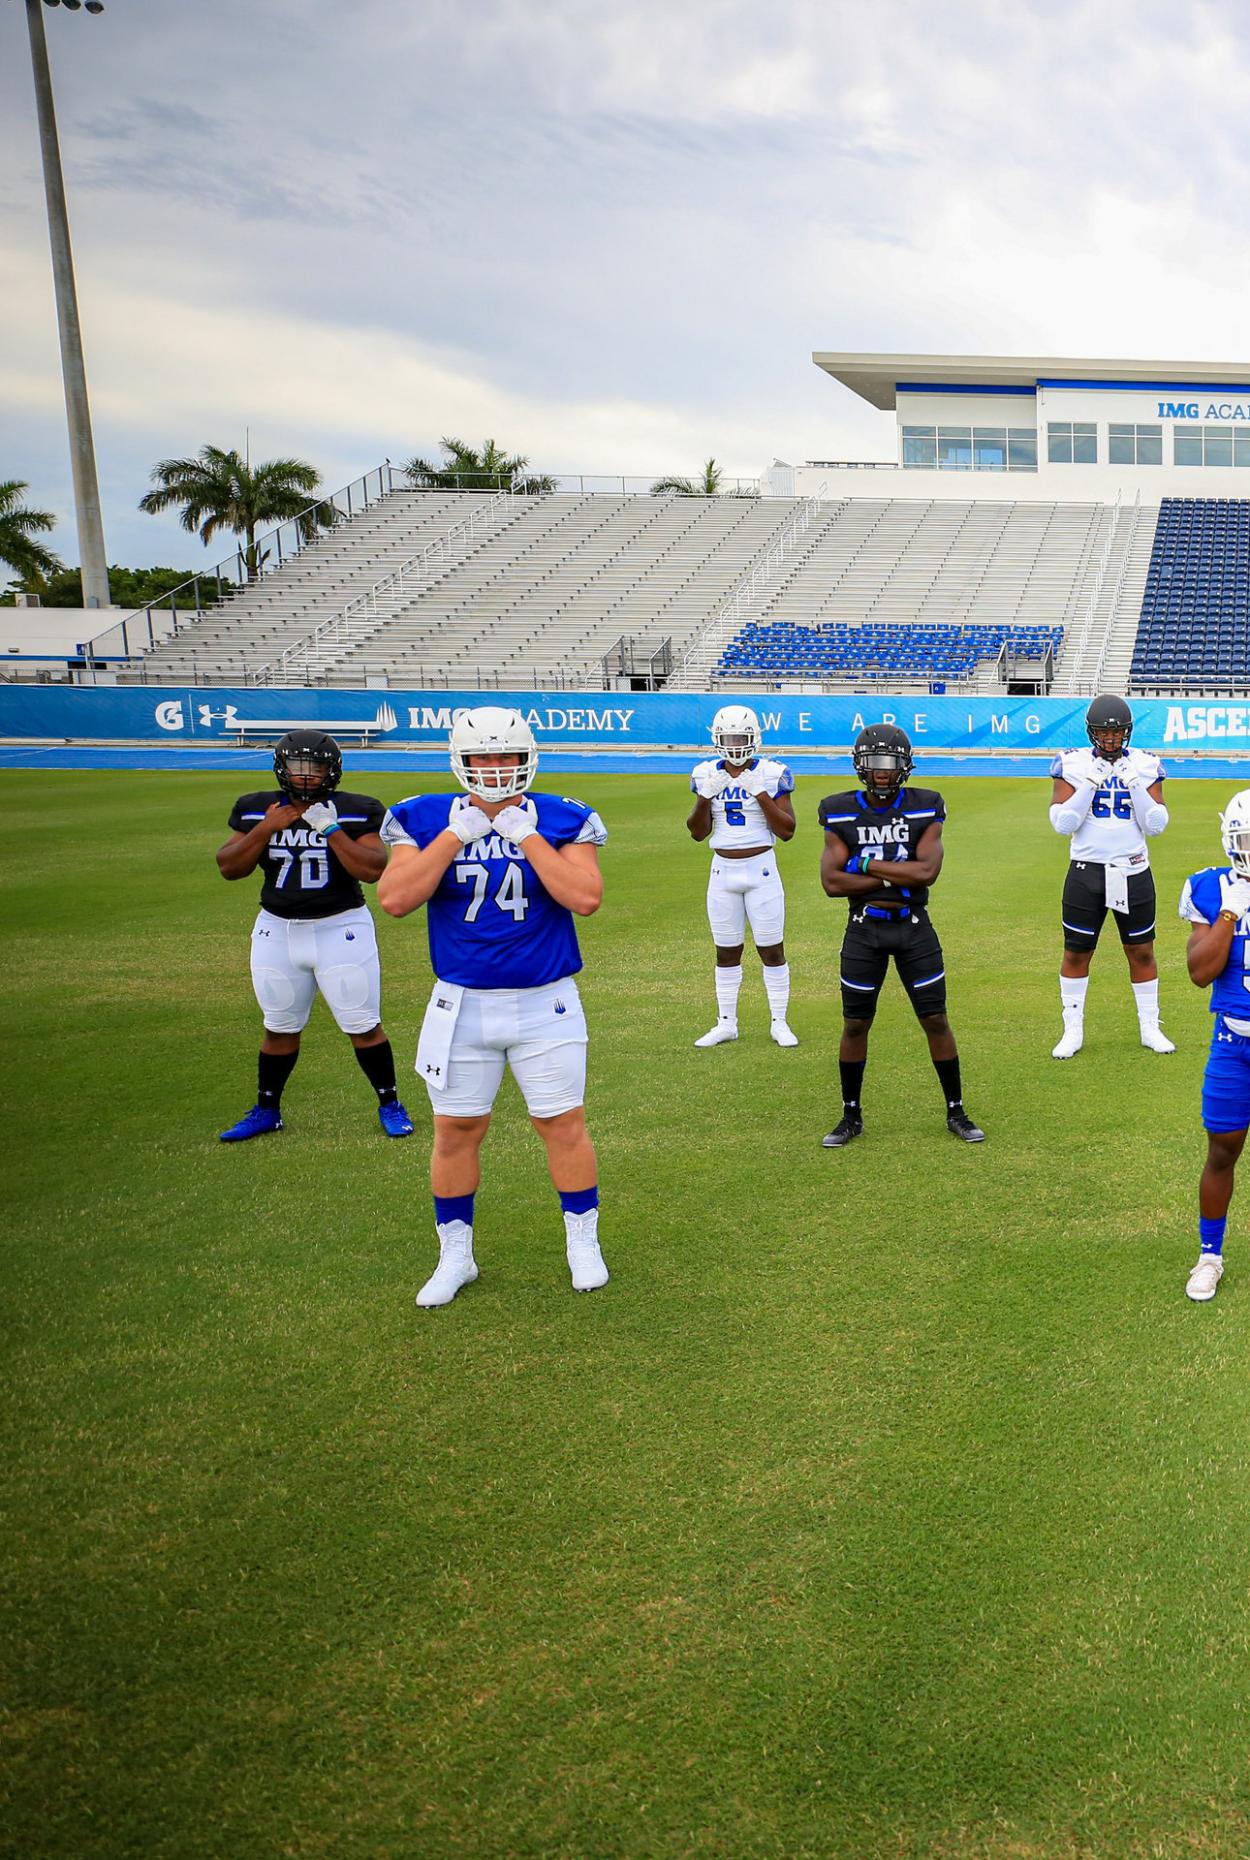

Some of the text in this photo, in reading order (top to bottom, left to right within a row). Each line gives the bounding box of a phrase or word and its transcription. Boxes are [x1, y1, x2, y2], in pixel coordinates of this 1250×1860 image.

[1158, 403, 1199, 418] IMG
[514, 708, 634, 731] ADEMY
[762, 713, 813, 732] WE
[968, 714, 1041, 734] IMG
[1092, 790, 1132, 820] 66
[268, 829, 328, 848] IMG
[857, 824, 910, 845] IMG
[268, 848, 329, 889] 70
[455, 862, 530, 922] 74
